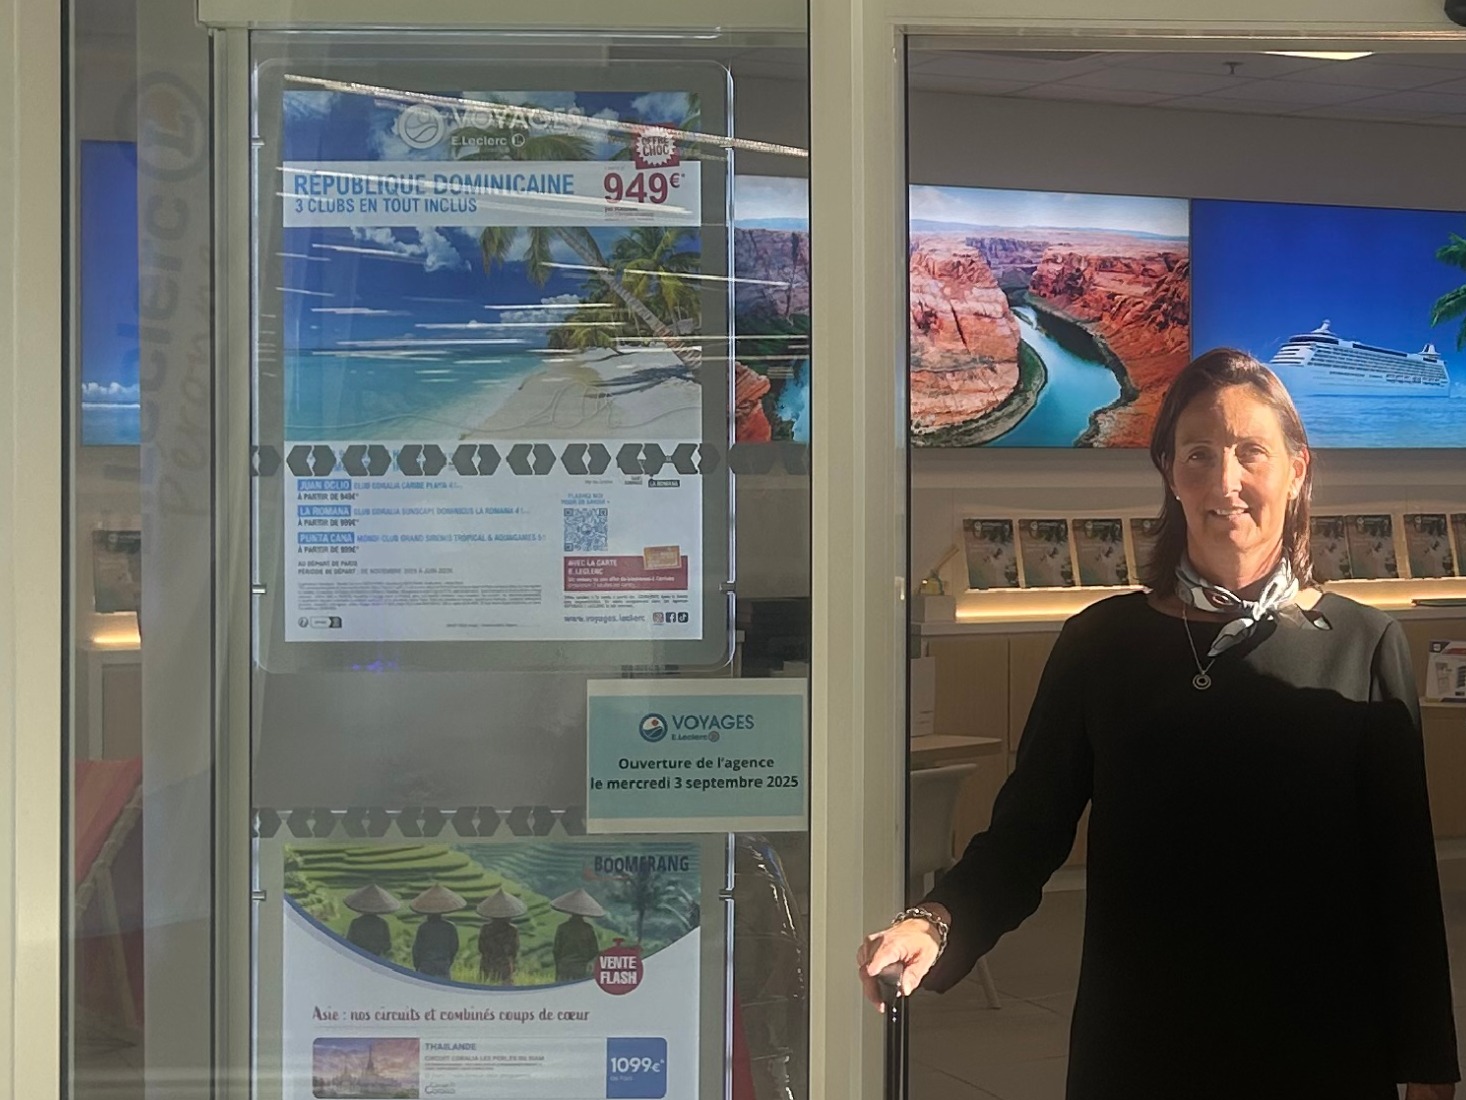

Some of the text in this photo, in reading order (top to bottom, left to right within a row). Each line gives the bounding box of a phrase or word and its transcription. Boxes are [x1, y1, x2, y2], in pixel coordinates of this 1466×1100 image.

[452, 106, 584, 130] VOYAGES
[451, 136, 507, 147] E.Leclerc
[641, 136, 669, 146] OFFRE
[643, 146, 669, 157] CHOC
[294, 171, 574, 195] RÉPUBLIQUE DOMINICAINE
[296, 198, 477, 213] 3 CLUBS EN TOUT INCLUS
[672, 714, 755, 730] VOYAGES
[618, 758, 692, 770] Ouverture
[696, 757, 713, 770] de
[590, 776, 799, 792] le mercredi 3 septembre 2025
[600, 956, 637, 969] VENTE
[600, 971, 637, 985] FLASH
[312, 1006, 339, 1021] Asie
[351, 1010, 371, 1021] nos
[374, 1006, 420, 1021] circuits
[424, 1008, 436, 1021] et
[440, 1006, 495, 1021] combinés
[499, 1010, 535, 1024] coups
[538, 1007, 553, 1021] de
